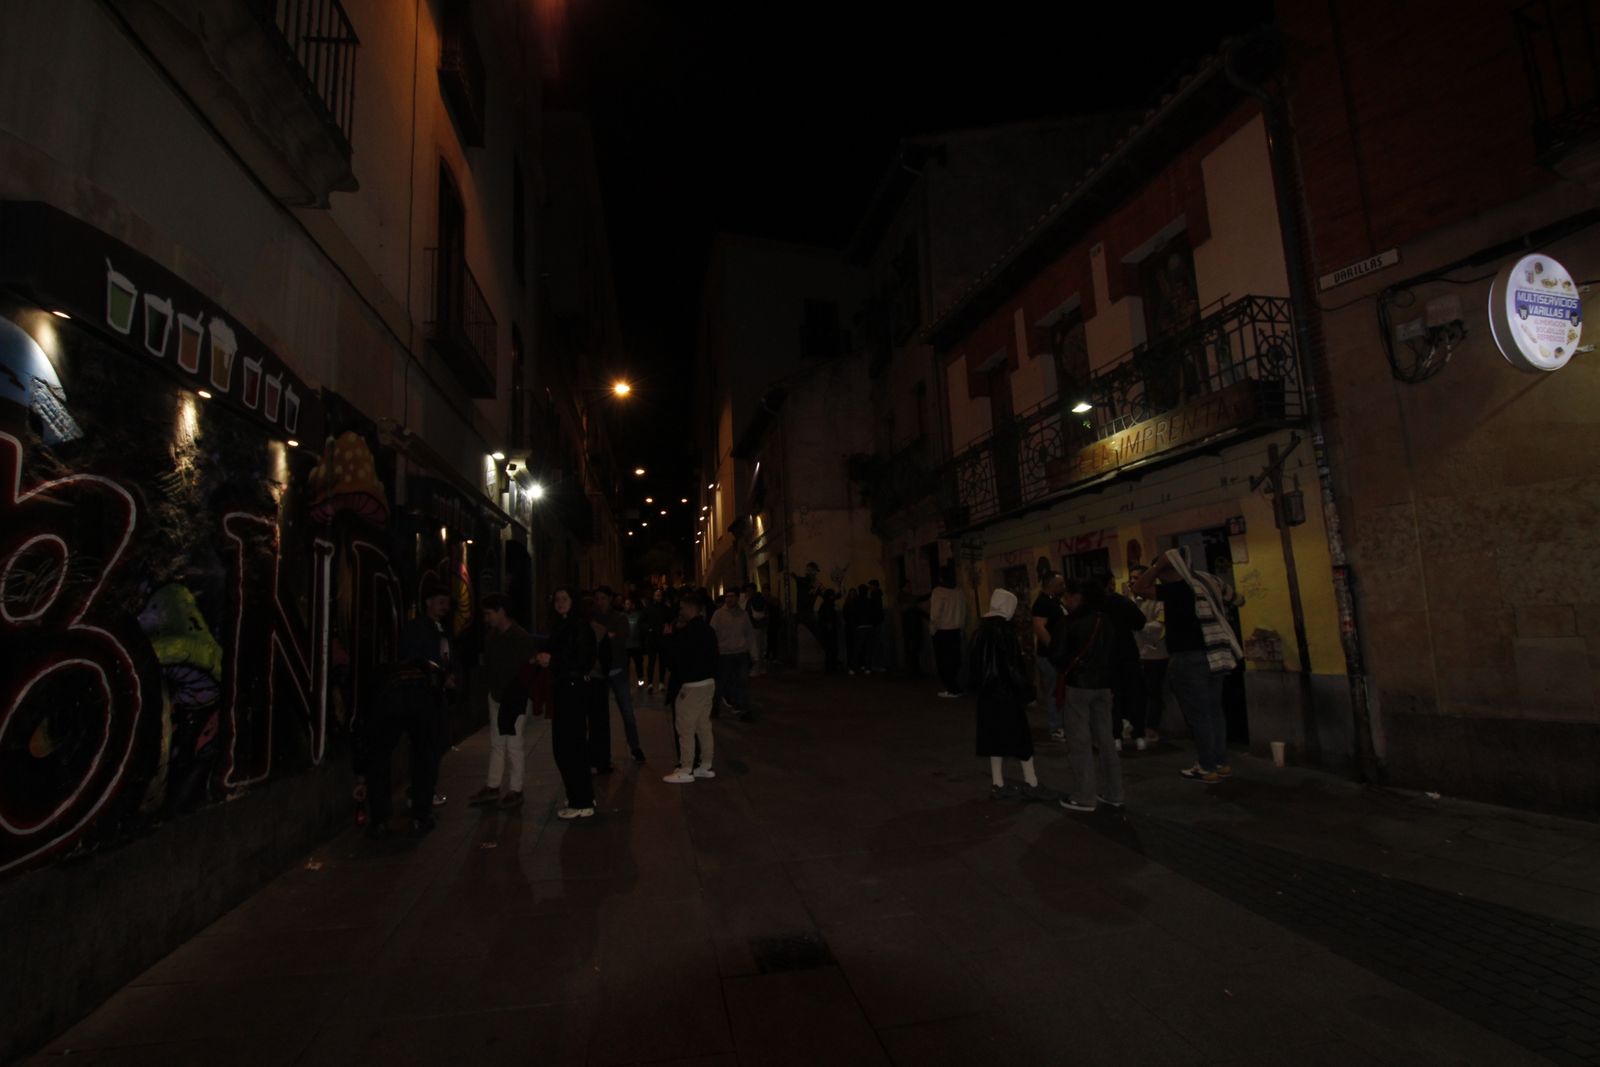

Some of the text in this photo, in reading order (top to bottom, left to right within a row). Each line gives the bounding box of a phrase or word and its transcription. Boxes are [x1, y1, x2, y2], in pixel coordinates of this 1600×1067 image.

[1334, 256, 1383, 283] VARILLAS
[1517, 291, 1577, 309] MULTISERVICIOS
[1529, 304, 1564, 318] VARILLAS
[1117, 396, 1232, 461] IMPRENTA
